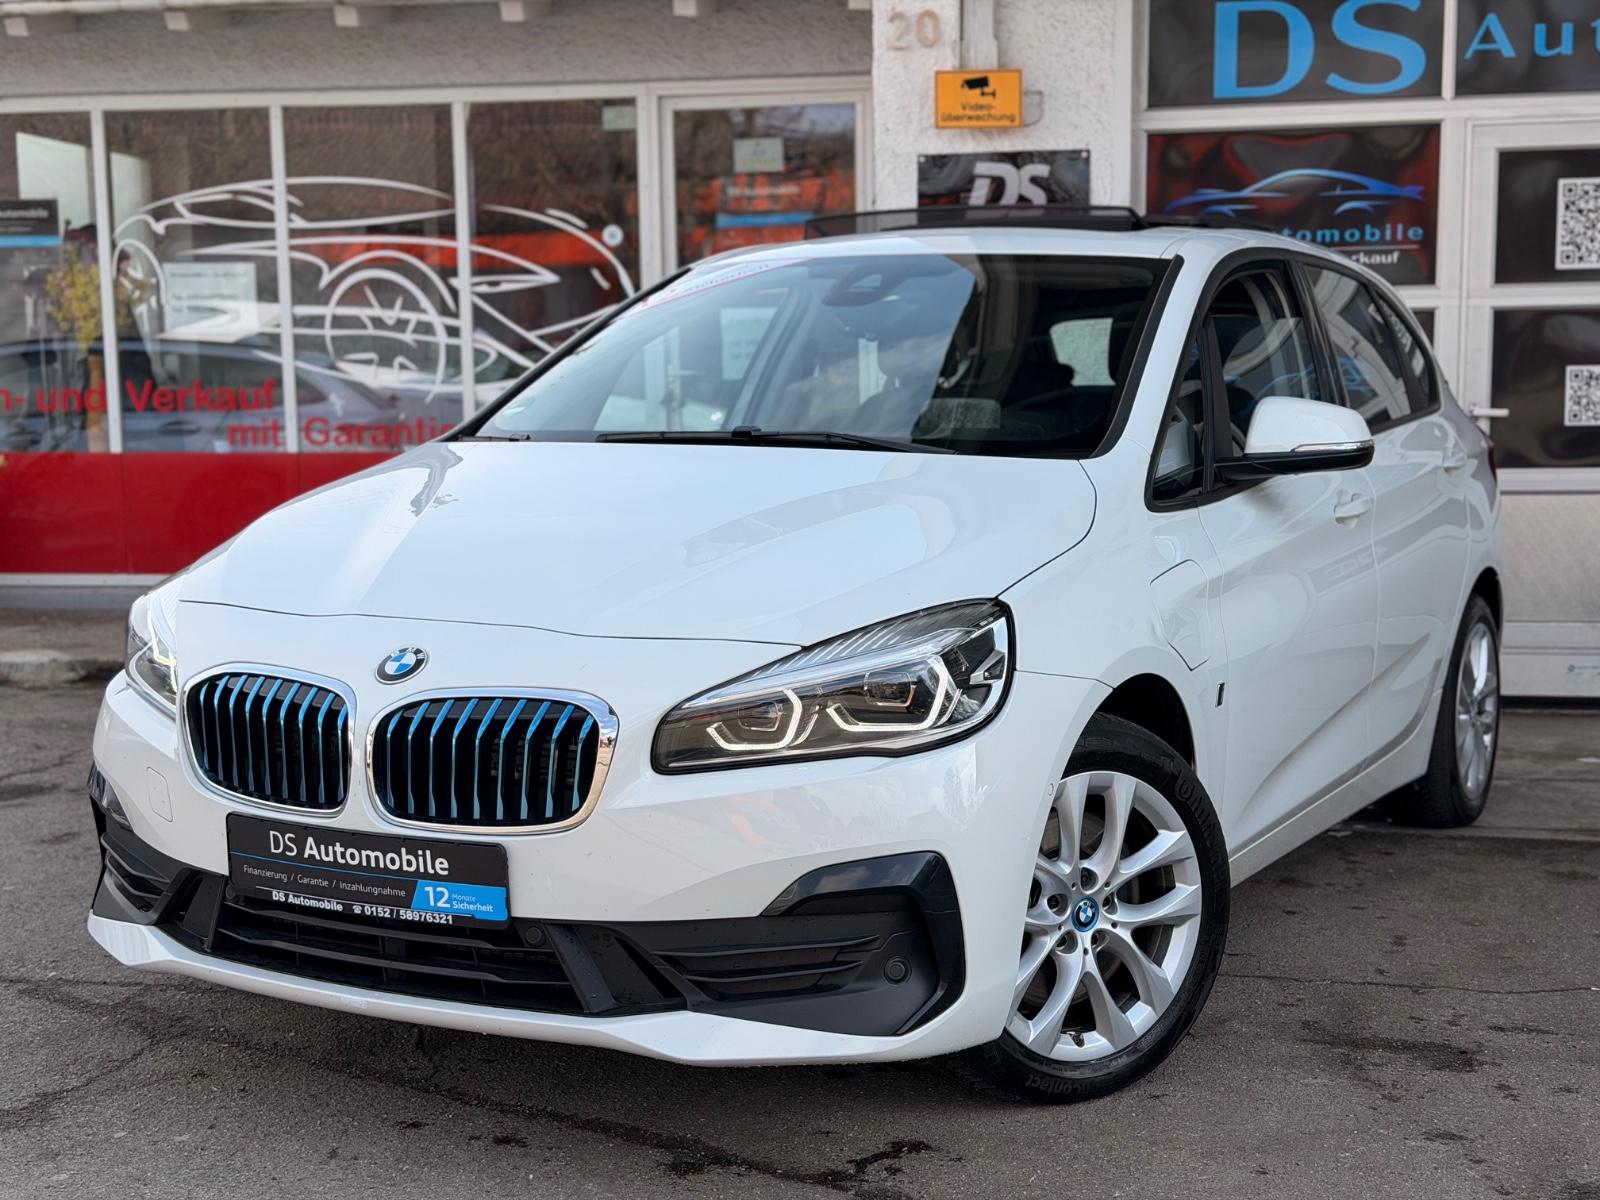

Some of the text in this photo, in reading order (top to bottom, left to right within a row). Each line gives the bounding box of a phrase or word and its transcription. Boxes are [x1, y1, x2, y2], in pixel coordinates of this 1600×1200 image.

[887, 9, 941, 50] 20
[1213, 0, 1427, 98] DS
[960, 102, 995, 112] Video-
[968, 161, 1051, 207] DS
[35, 378, 107, 413] und
[125, 377, 278, 413] Verkauf
[227, 417, 282, 447] mit
[269, 830, 450, 876] DS Automobile
[243, 864, 288, 883] Finanzierung
[297, 874, 329, 888] Garantie
[339, 882, 406, 897] Inzahlungnahme
[424, 886, 451, 908] 12
[451, 893, 476, 902] Monate
[272, 890, 286, 902] DS
[287, 894, 343, 912] Automobile
[364, 906, 391, 918] 0152
[399, 909, 453, 925] 58976321
[452, 901, 494, 912] Sicherheit
